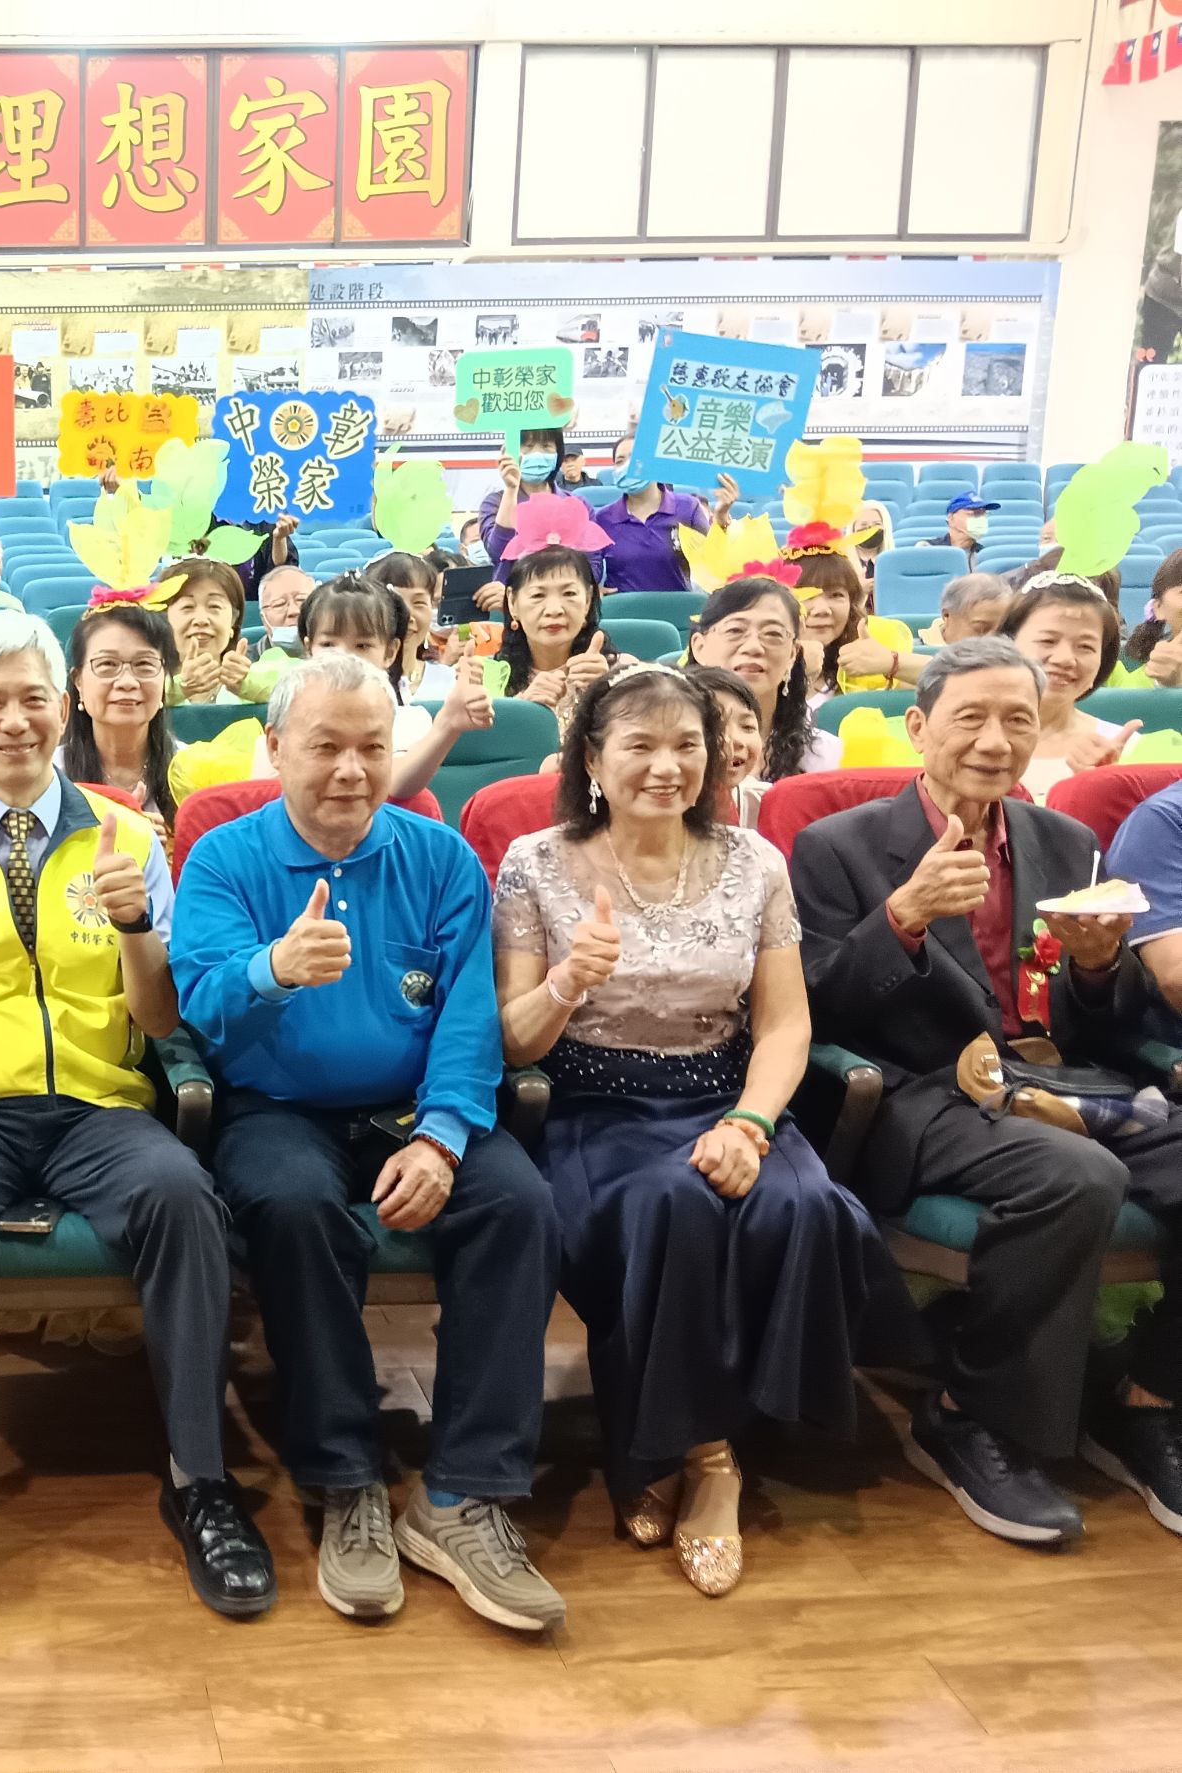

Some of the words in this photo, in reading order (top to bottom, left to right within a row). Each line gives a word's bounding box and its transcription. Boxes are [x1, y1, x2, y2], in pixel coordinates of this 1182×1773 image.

[309, 281, 384, 301] 建設階段
[472, 364, 557, 389] 中彰榮家
[481, 390, 545, 413] 歡迎您
[696, 398, 754, 432] 音樂
[661, 428, 773, 470] 公益表演
[251, 454, 338, 513] 榮家
